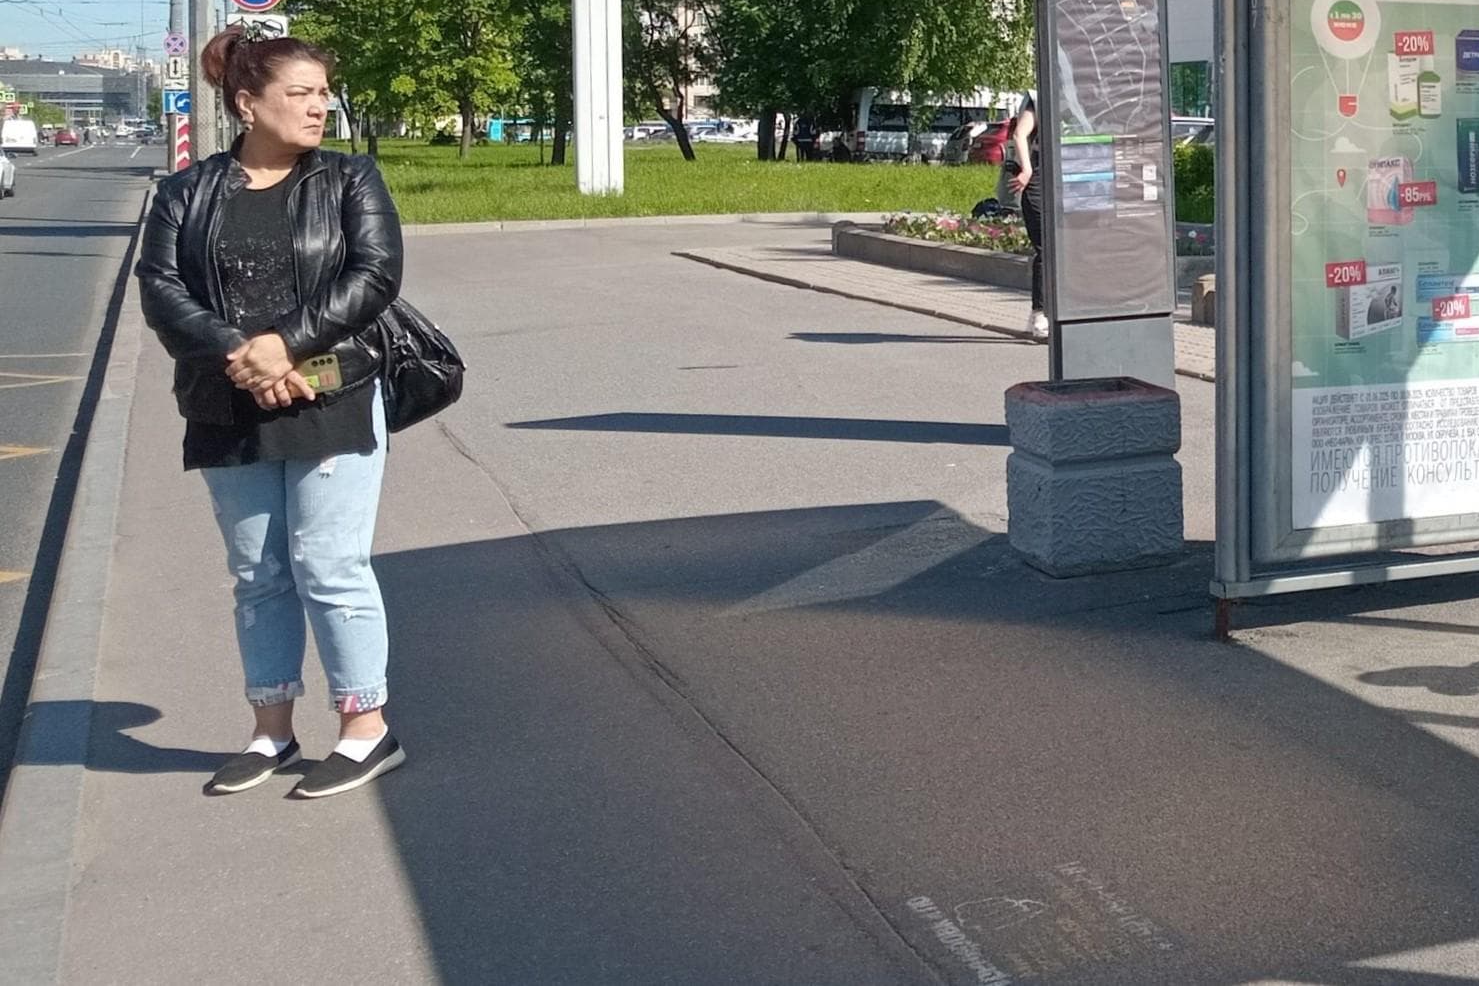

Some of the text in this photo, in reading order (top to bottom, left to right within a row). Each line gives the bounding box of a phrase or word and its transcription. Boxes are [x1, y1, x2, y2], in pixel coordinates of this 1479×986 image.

[1398, 35, 1430, 52] -20%
[1328, 265, 1362, 284] -20%
[1434, 300, 1466, 317] -20%
[1311, 444, 1380, 471] ИМЕЮТСЯ
[1310, 465, 1398, 494] ПОЛУЧЕНИЕ
